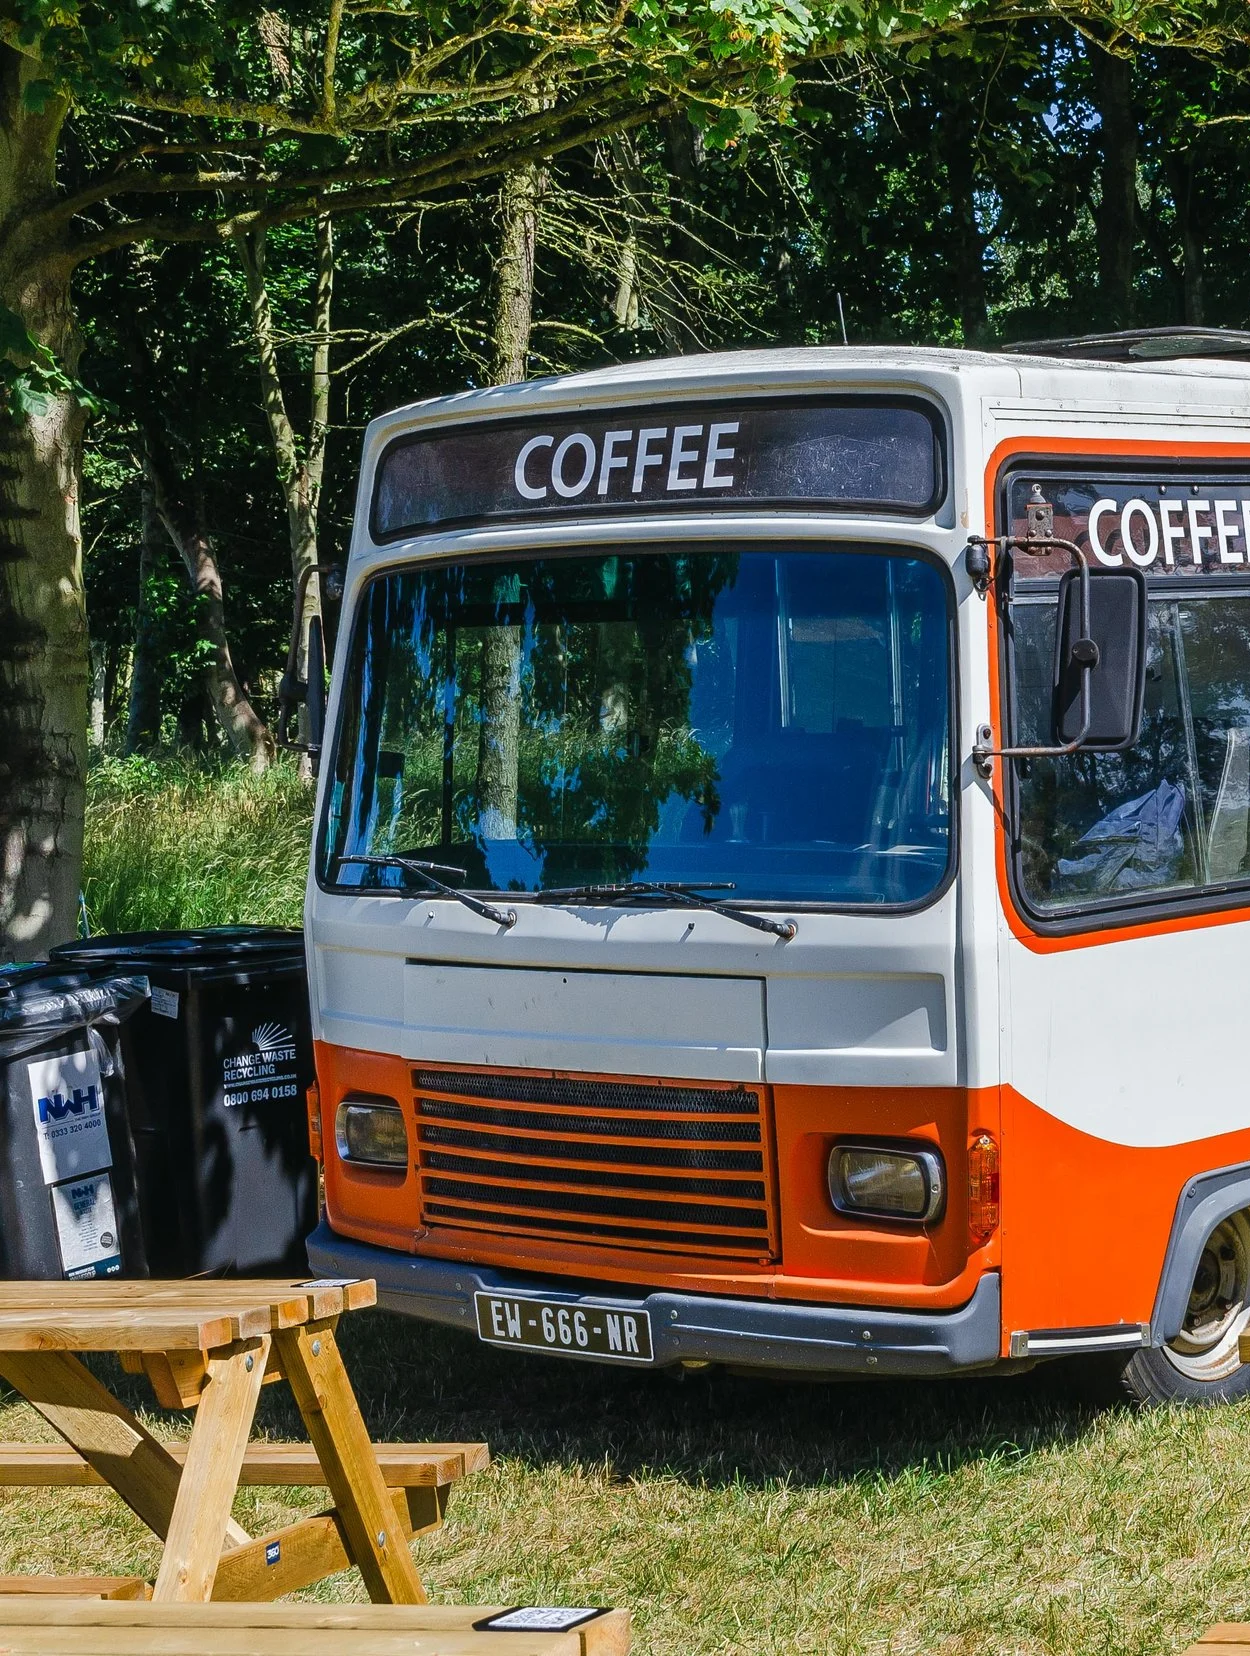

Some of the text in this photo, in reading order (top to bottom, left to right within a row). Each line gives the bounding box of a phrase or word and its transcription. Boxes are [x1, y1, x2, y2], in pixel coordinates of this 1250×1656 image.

[515, 421, 739, 499] COFFEE
[223, 1049, 296, 1069] CHANGE WASTE
[224, 1064, 275, 1081] RECYCLING
[37, 1085, 99, 1124] NWH
[224, 1084, 297, 1106] 0800 694 0158
[51, 1127, 68, 1139] 0333
[70, 1124, 82, 1133] 320
[85, 1119, 101, 1129] 4000
[490, 1300, 639, 1353] EW-666-NR
